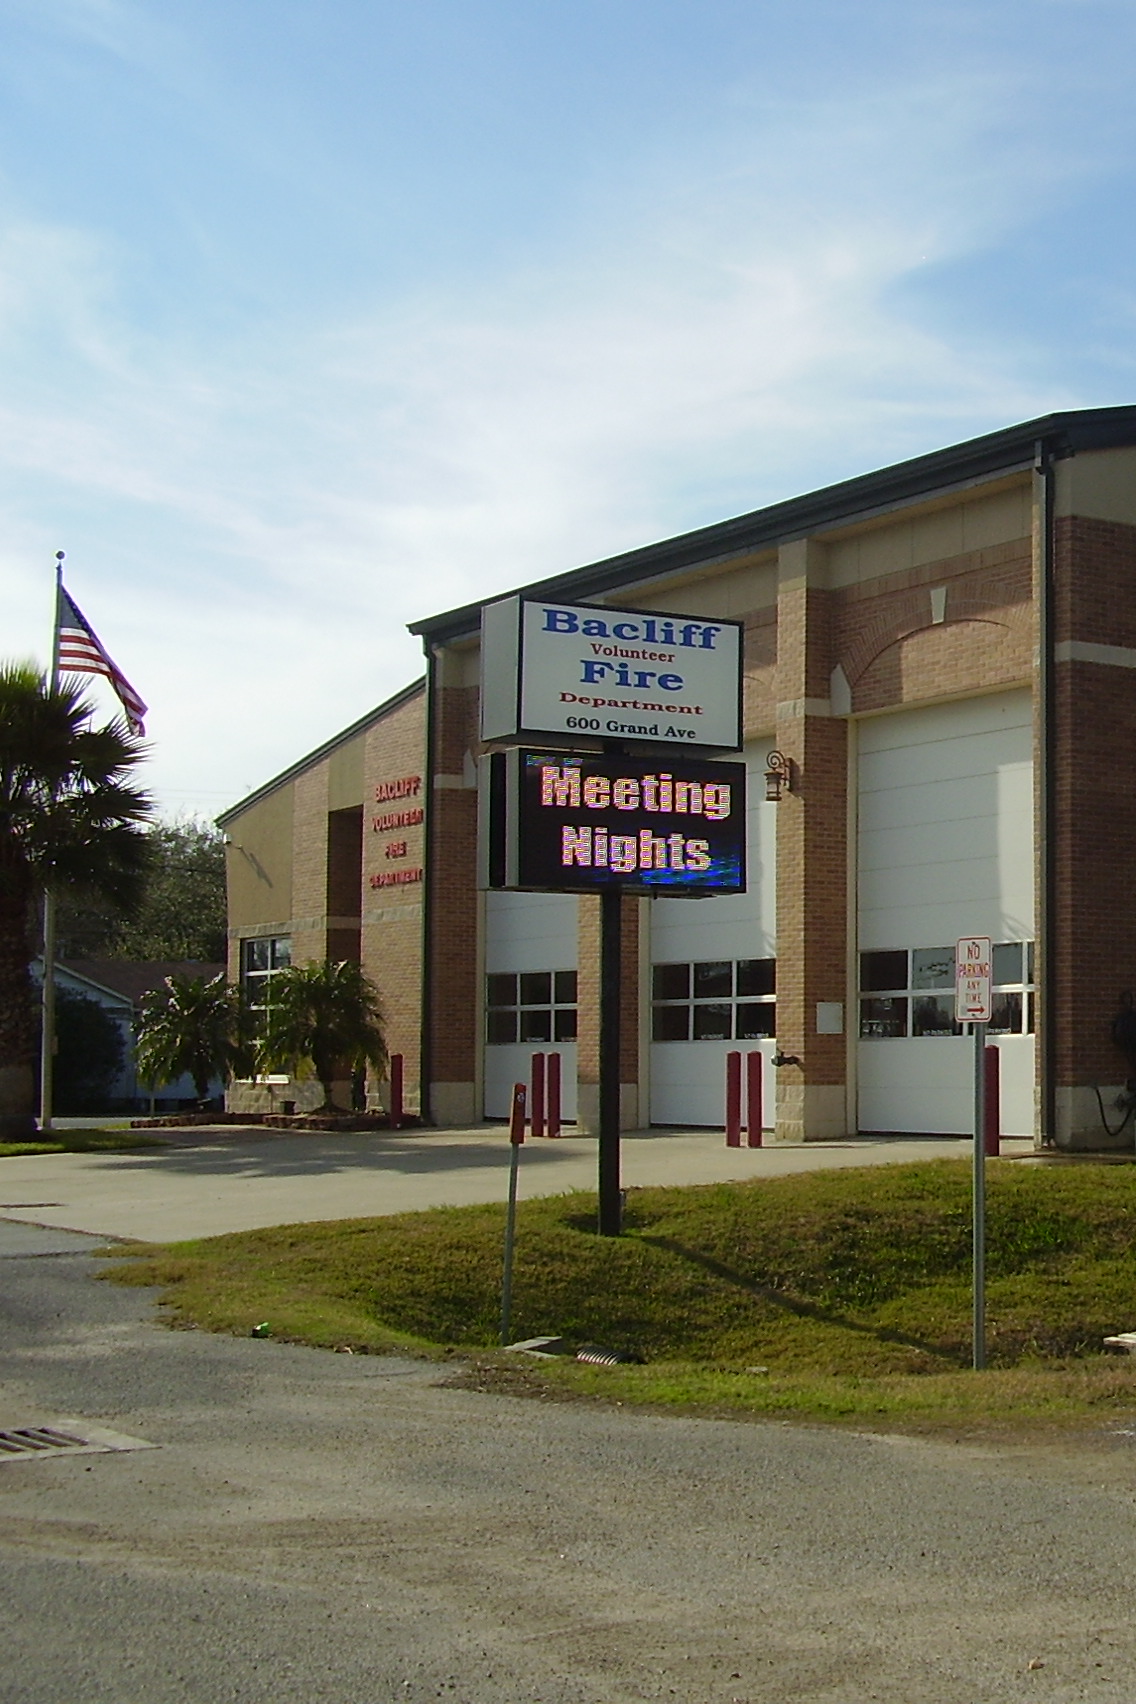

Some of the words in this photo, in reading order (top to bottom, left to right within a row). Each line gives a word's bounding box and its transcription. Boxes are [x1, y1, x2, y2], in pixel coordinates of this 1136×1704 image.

[541, 608, 721, 650] Bacliff
[590, 642, 676, 664] Volunteer
[579, 659, 684, 691] Fire
[559, 691, 704, 716] Department
[566, 716, 600, 731] 600
[606, 720, 659, 736] Grand
[665, 725, 697, 739] Ave
[375, 775, 421, 803] BACLIFF
[541, 765, 731, 820] Meeting
[372, 808, 424, 833] VOLUNTEER
[561, 825, 712, 872] Nights
[967, 945, 980, 960] NO
[959, 963, 989, 978] PARKING
[965, 992, 982, 1004] TIME
[967, 980, 980, 991] ANY
